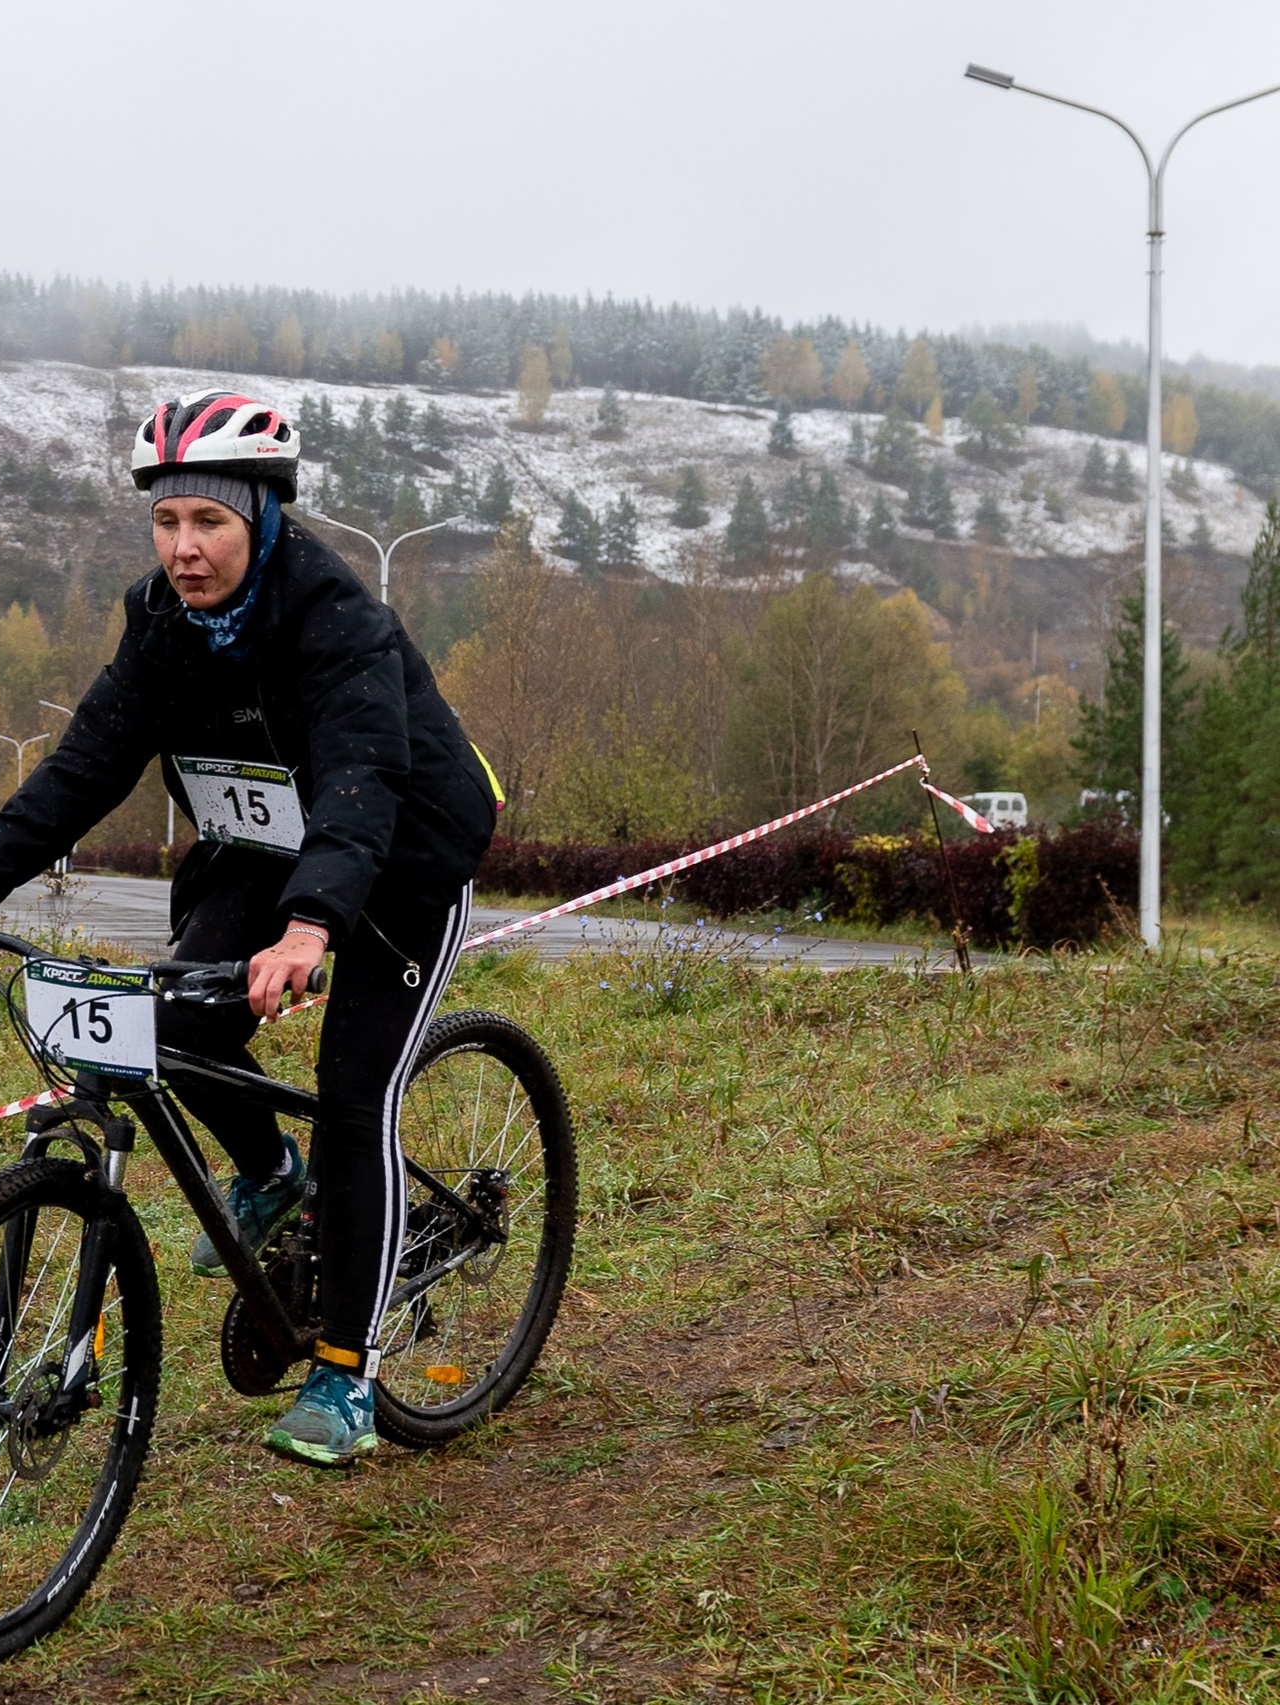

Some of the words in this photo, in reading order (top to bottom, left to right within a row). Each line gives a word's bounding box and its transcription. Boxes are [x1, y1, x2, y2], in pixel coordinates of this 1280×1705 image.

[197, 762, 238, 774] КРОСС
[240, 767, 286, 781] ДУАТЛОН
[223, 786, 271, 826] 15
[42, 966, 86, 983] КРОСС
[63, 998, 113, 1044] 15
